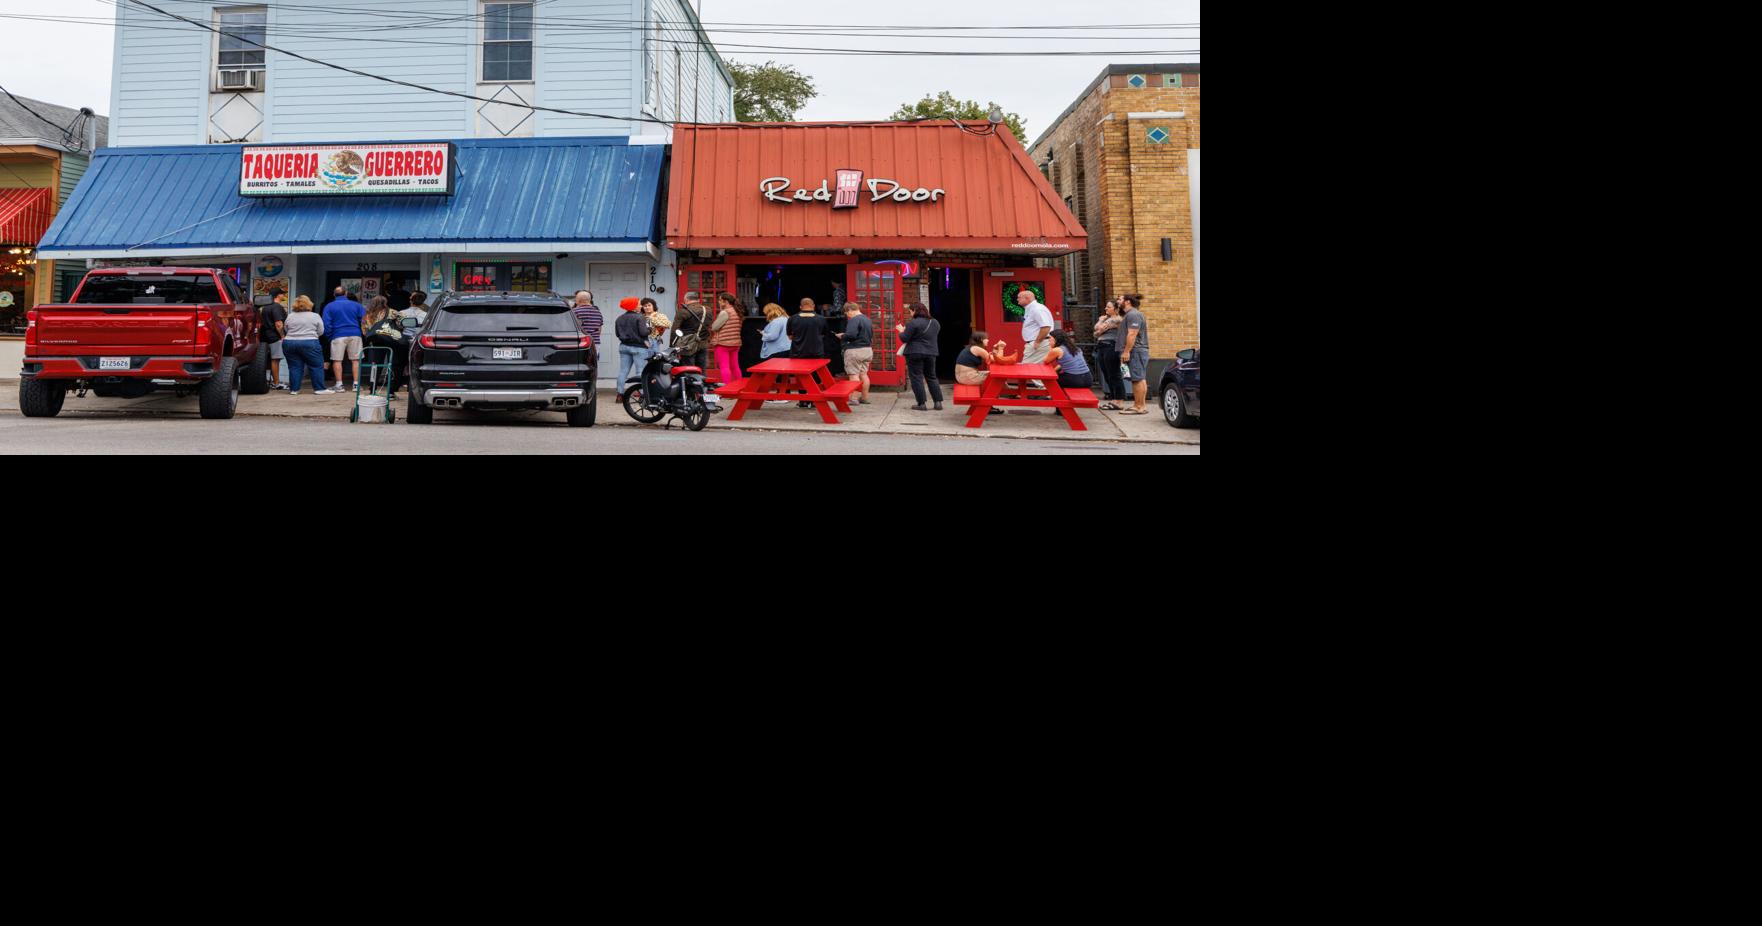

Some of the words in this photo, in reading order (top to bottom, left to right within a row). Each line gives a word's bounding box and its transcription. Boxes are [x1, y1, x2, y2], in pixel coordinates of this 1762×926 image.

[243, 153, 319, 180] TAQUERIA
[364, 150, 444, 176] GUERRERO
[760, 176, 832, 203] Red
[866, 178, 945, 202] Door
[357, 263, 377, 271] 208
[463, 274, 492, 285] OPEN
